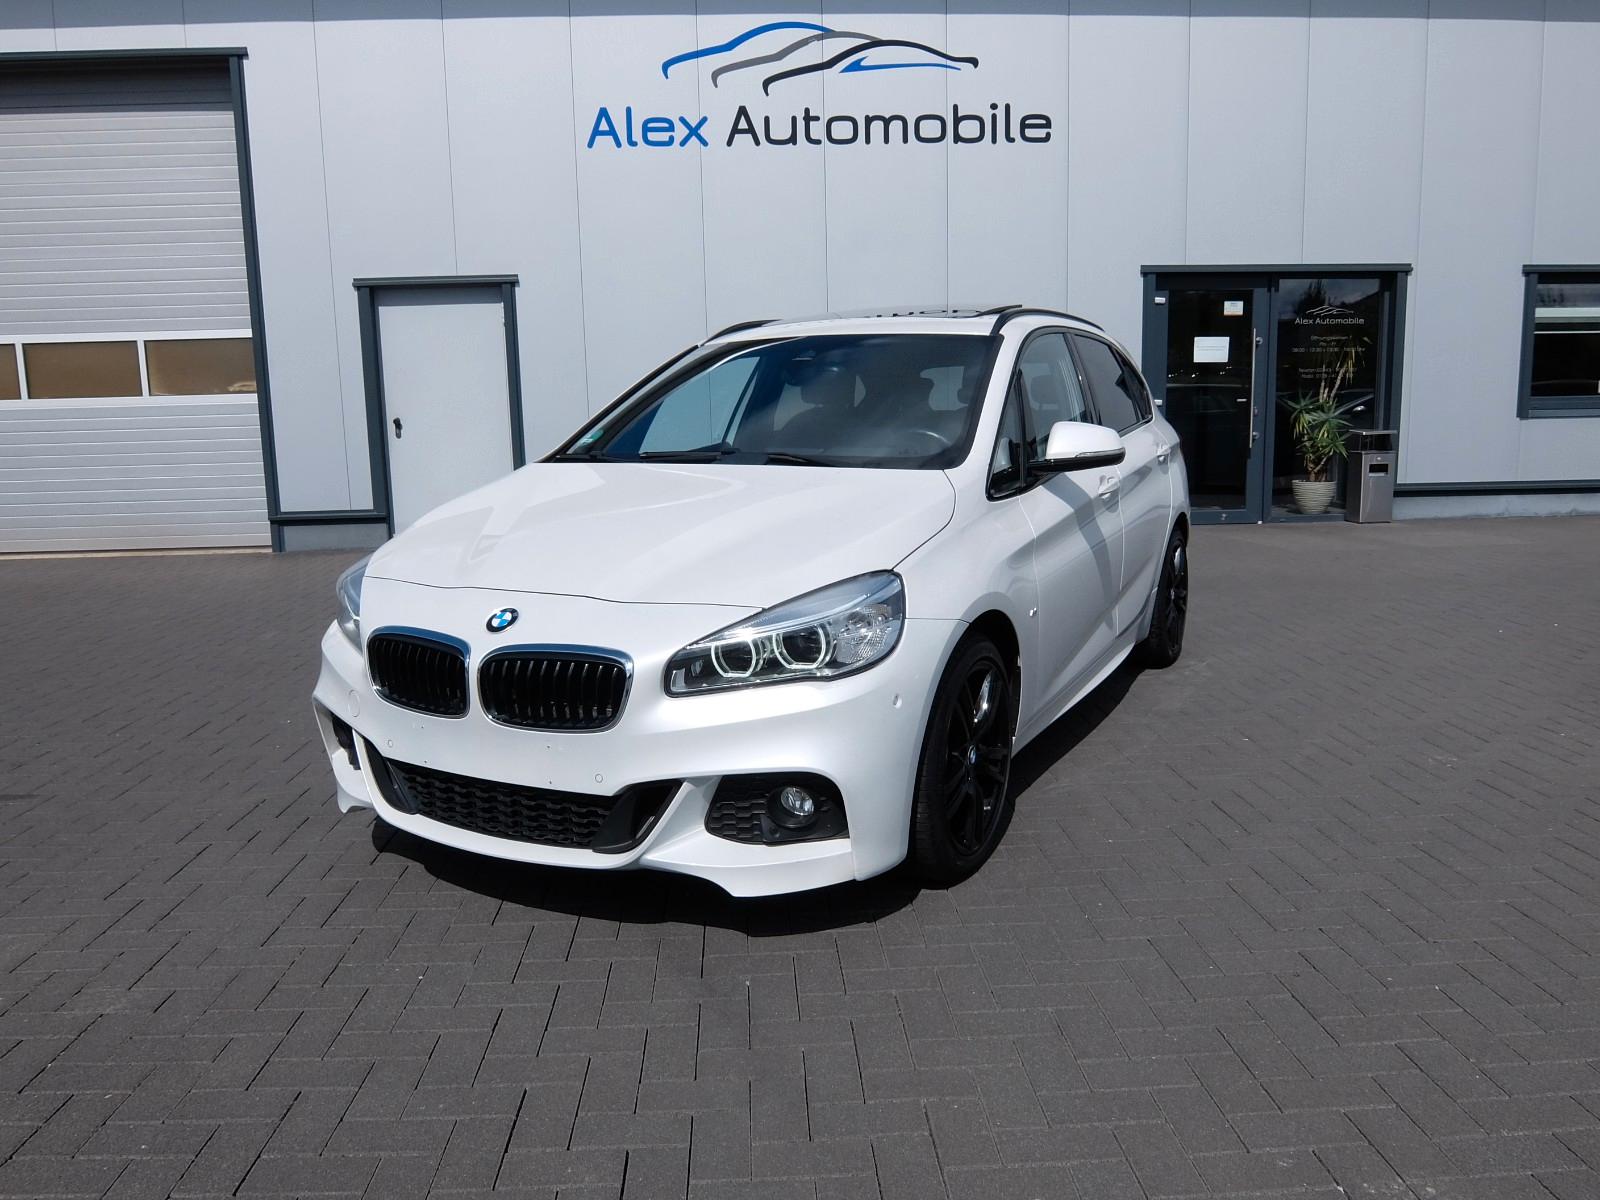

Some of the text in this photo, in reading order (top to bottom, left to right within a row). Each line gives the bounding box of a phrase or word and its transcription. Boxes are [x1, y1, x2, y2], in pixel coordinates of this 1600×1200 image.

[587, 102, 1052, 148] Alex Automobile
[1294, 316, 1365, 325] Alex Automobile
